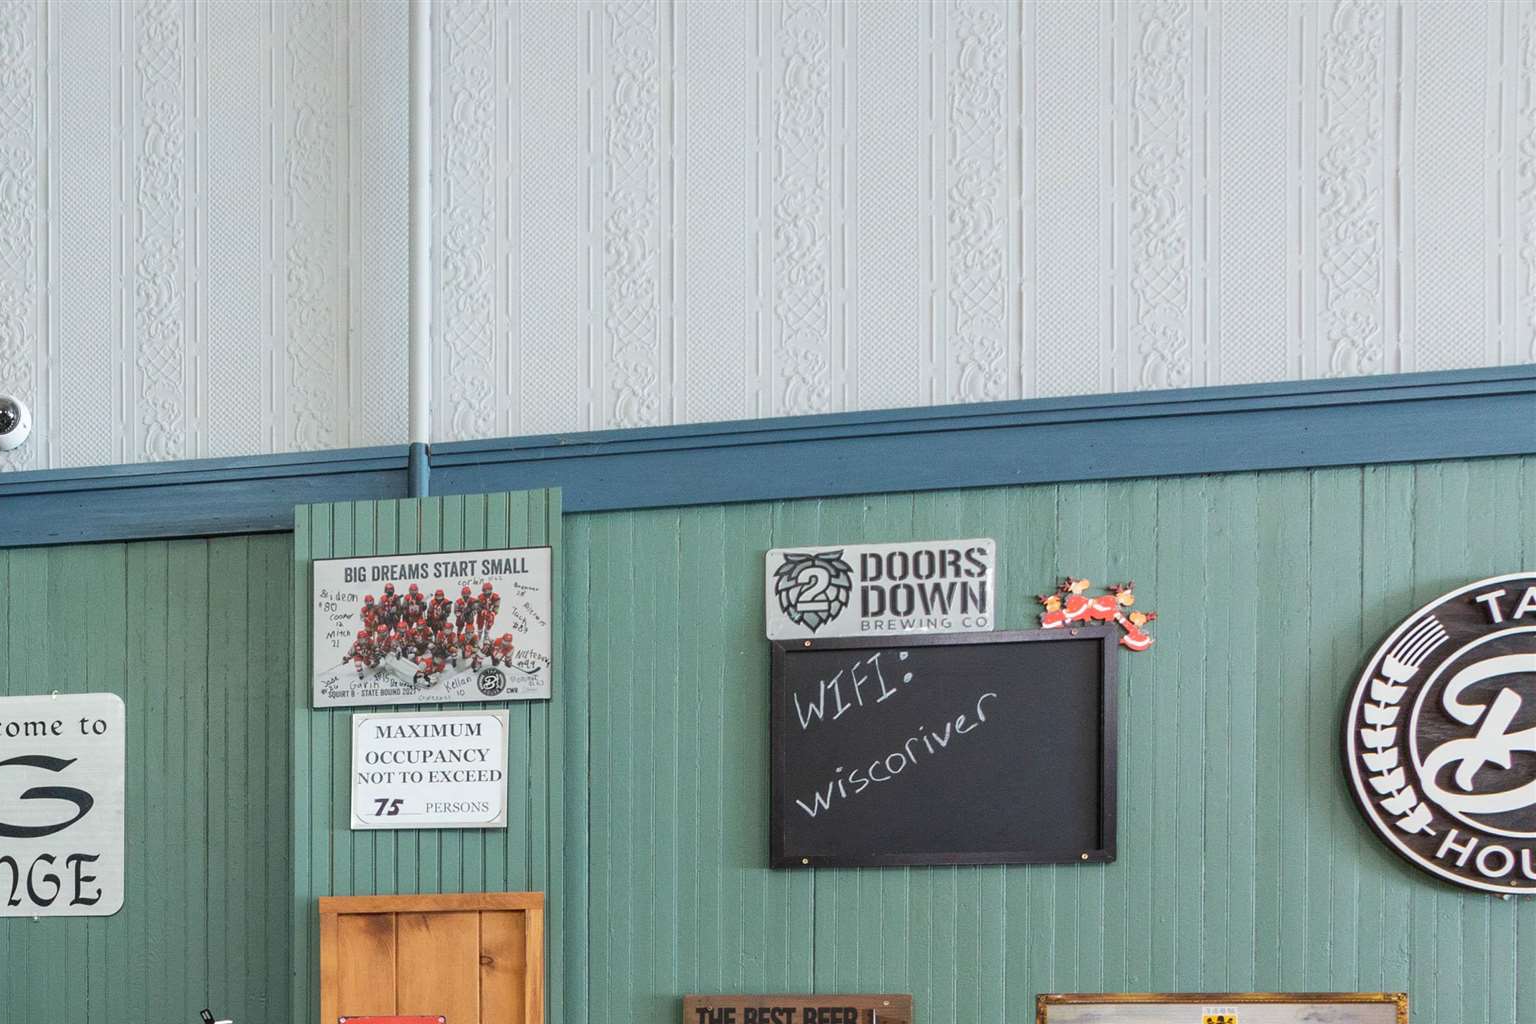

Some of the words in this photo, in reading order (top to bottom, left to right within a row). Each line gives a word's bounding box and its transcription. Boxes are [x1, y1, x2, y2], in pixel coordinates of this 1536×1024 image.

[344, 567, 366, 583] BIG
[371, 562, 429, 582] DREAMS
[433, 560, 477, 579] START
[482, 557, 529, 576] SMALL
[861, 547, 988, 582] DOORS
[861, 581, 988, 617] DOWN
[861, 617, 952, 631] BREWING
[961, 616, 988, 628] CO
[794, 651, 913, 729] WIFI:
[81, 717, 107, 735] to
[376, 723, 482, 739] MAXIMUM
[366, 749, 489, 765] OCCUPANCY
[795, 693, 998, 817] wiscoriver
[358, 771, 395, 785] NOT
[402, 771, 423, 783] TO
[429, 769, 502, 783] EXCEED
[374, 798, 404, 817] 75
[425, 802, 489, 813] PERSONS
